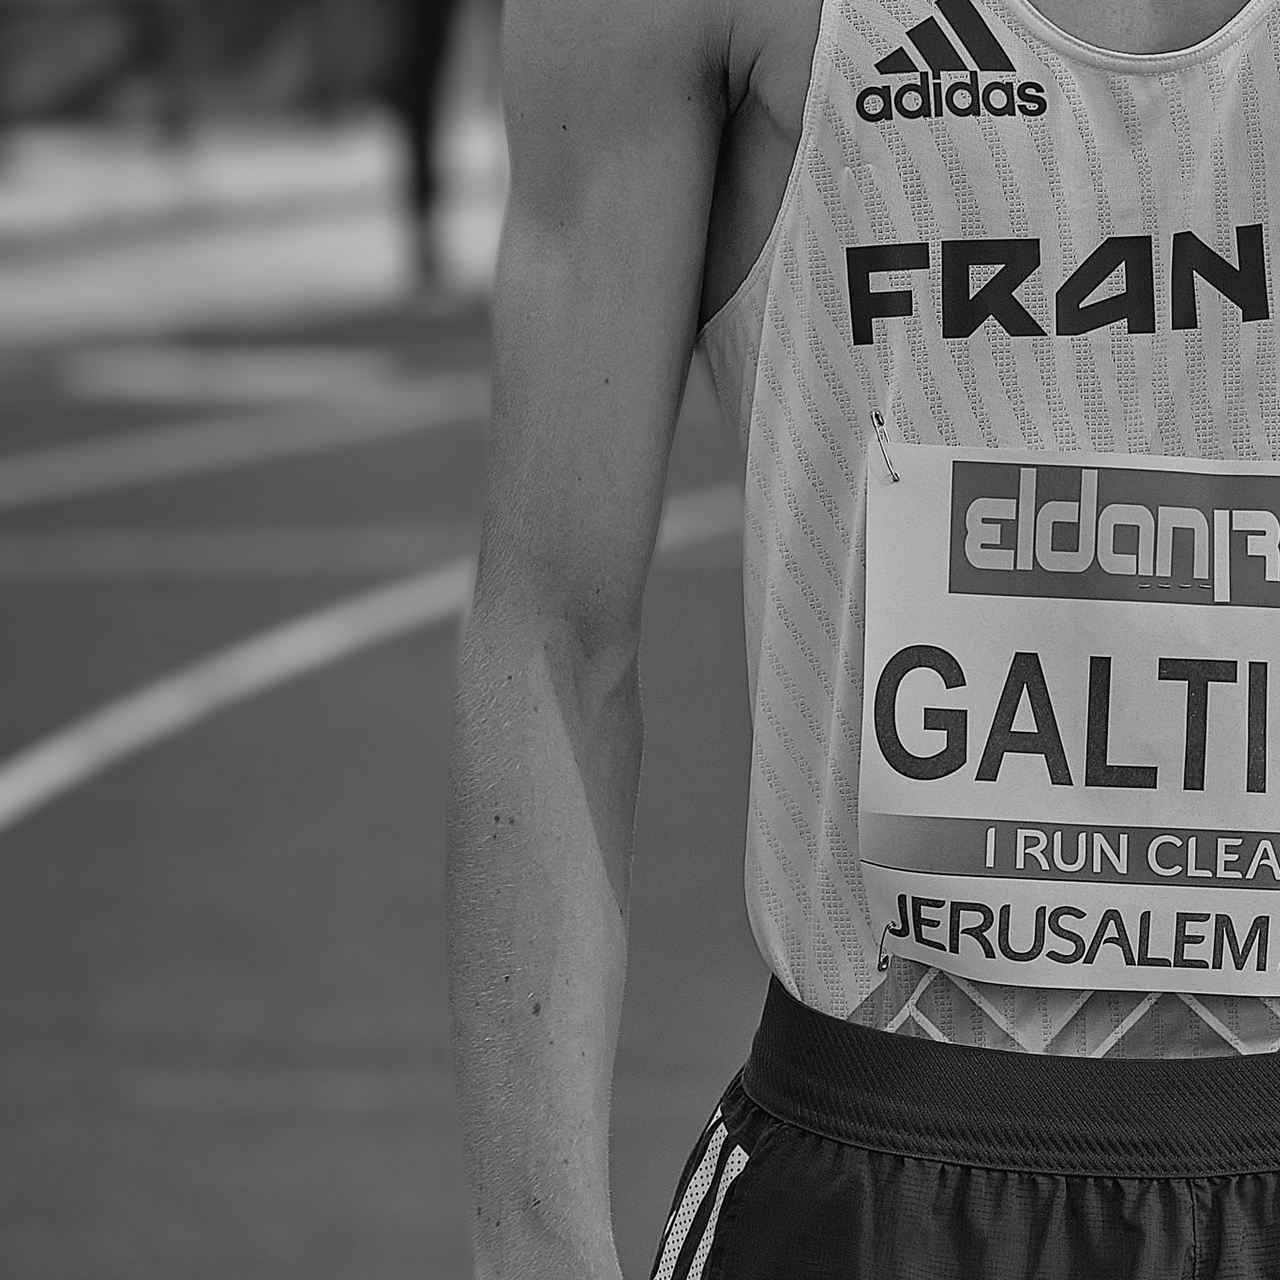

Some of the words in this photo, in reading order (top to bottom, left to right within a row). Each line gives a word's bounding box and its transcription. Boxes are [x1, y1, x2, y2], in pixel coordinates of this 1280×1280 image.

[855, 70, 1048, 123] adidas
[985, 827, 997, 869] I
[1015, 828, 1129, 875] RUN
[889, 893, 1270, 973] JERUSALEM
